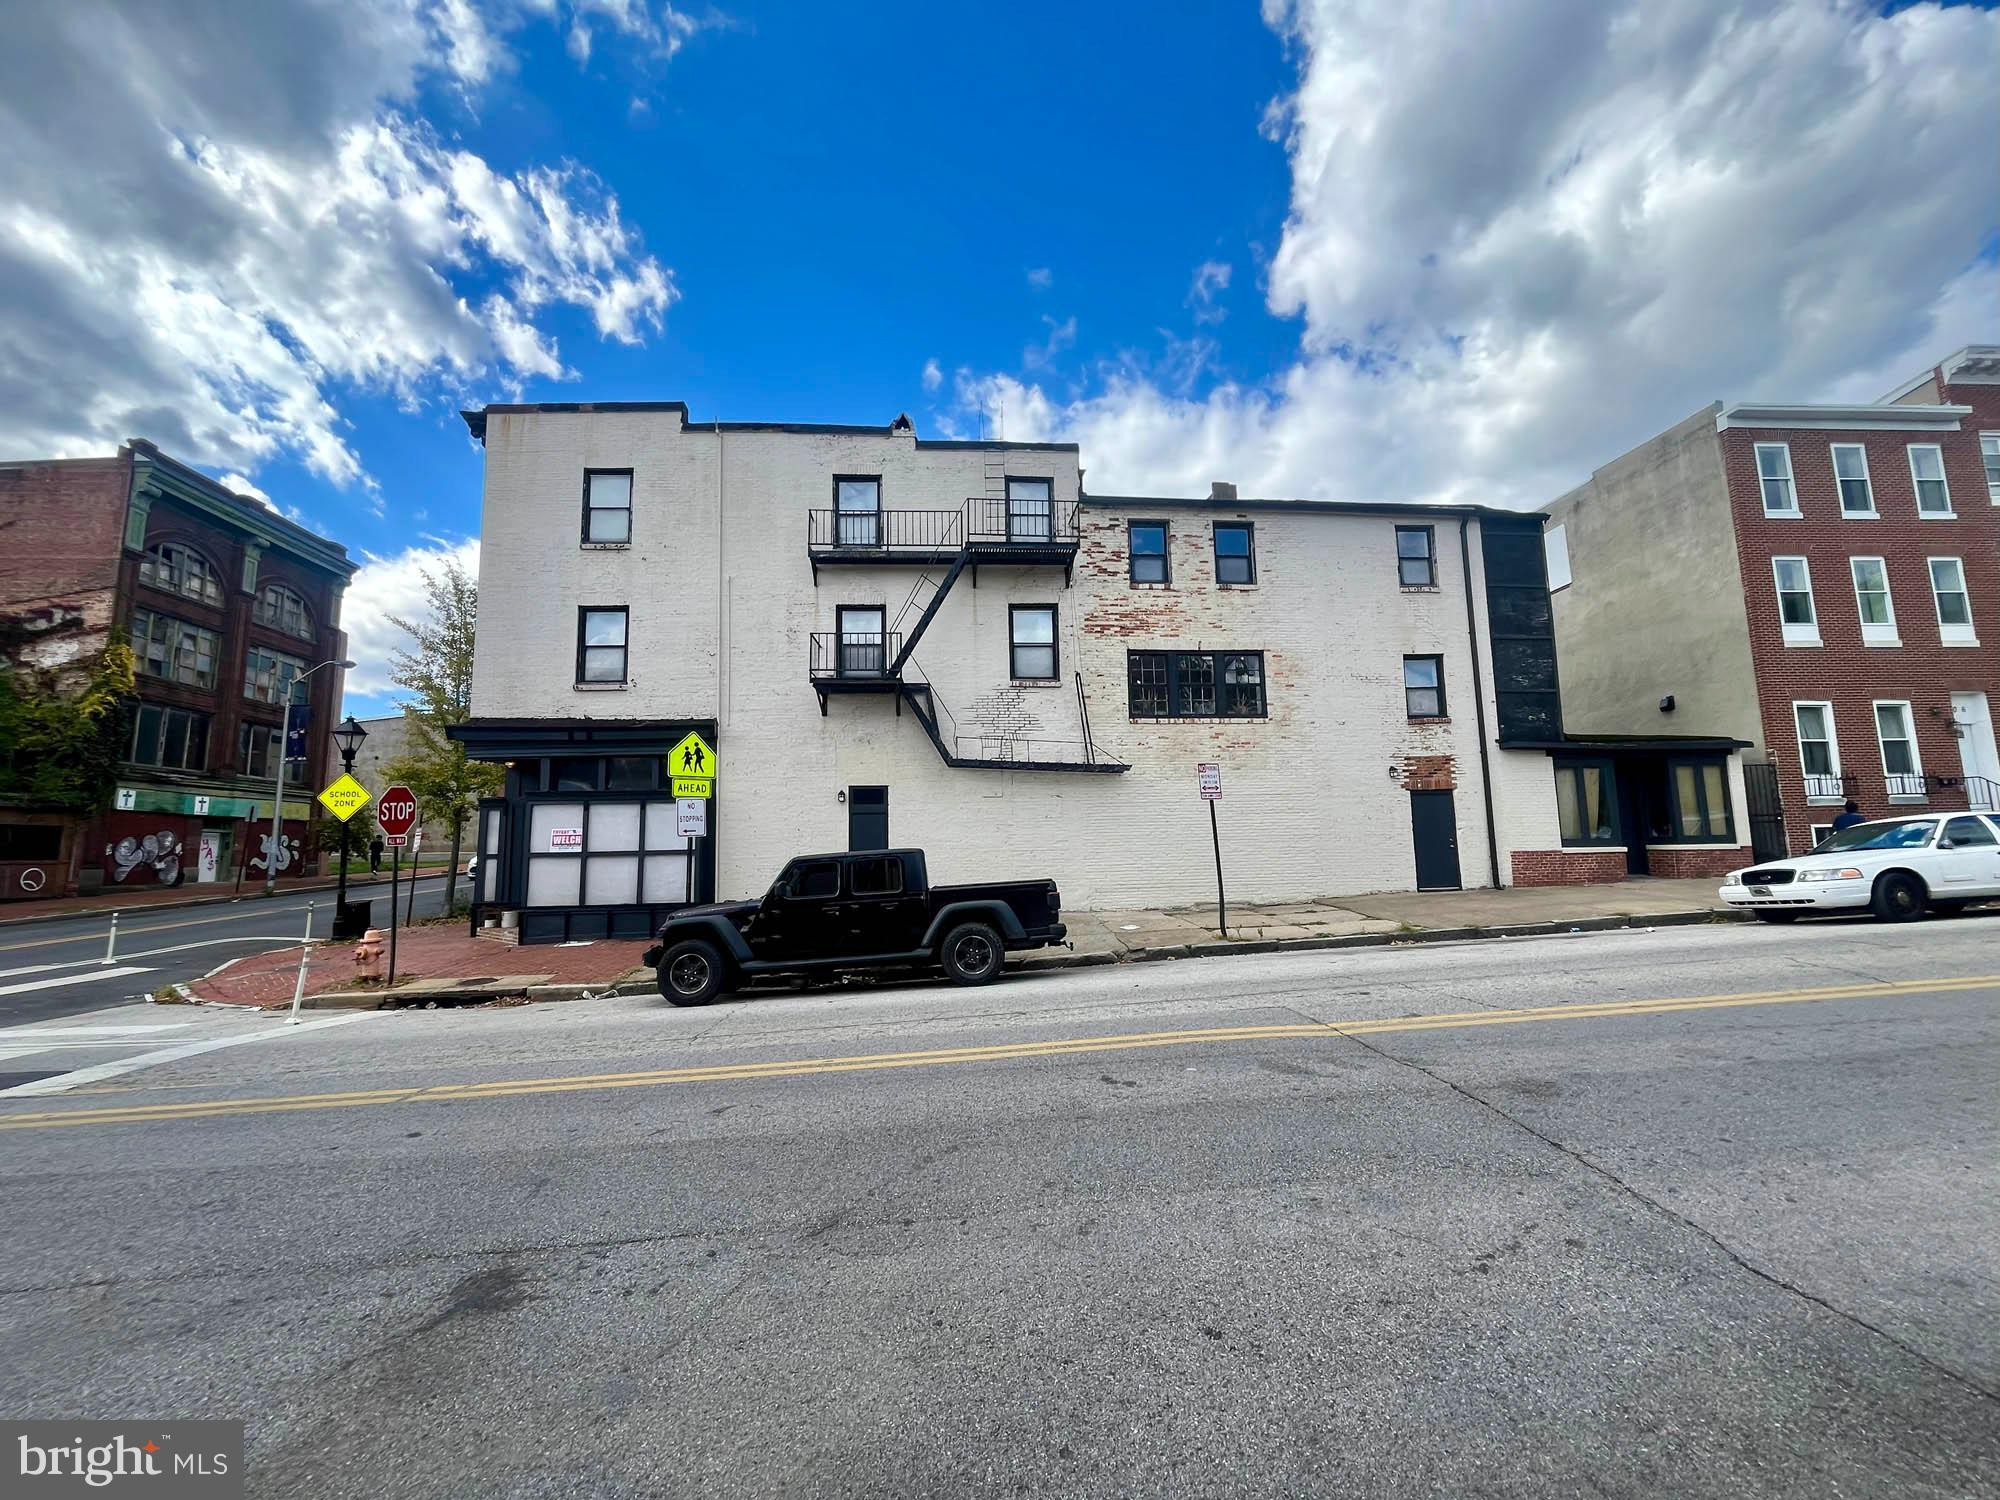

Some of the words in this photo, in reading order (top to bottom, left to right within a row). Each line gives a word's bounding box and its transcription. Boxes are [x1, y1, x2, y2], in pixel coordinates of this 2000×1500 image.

[678, 784, 707, 793] AHEAD
[380, 802, 414, 820] STOP
[553, 836, 581, 844] WELCH
